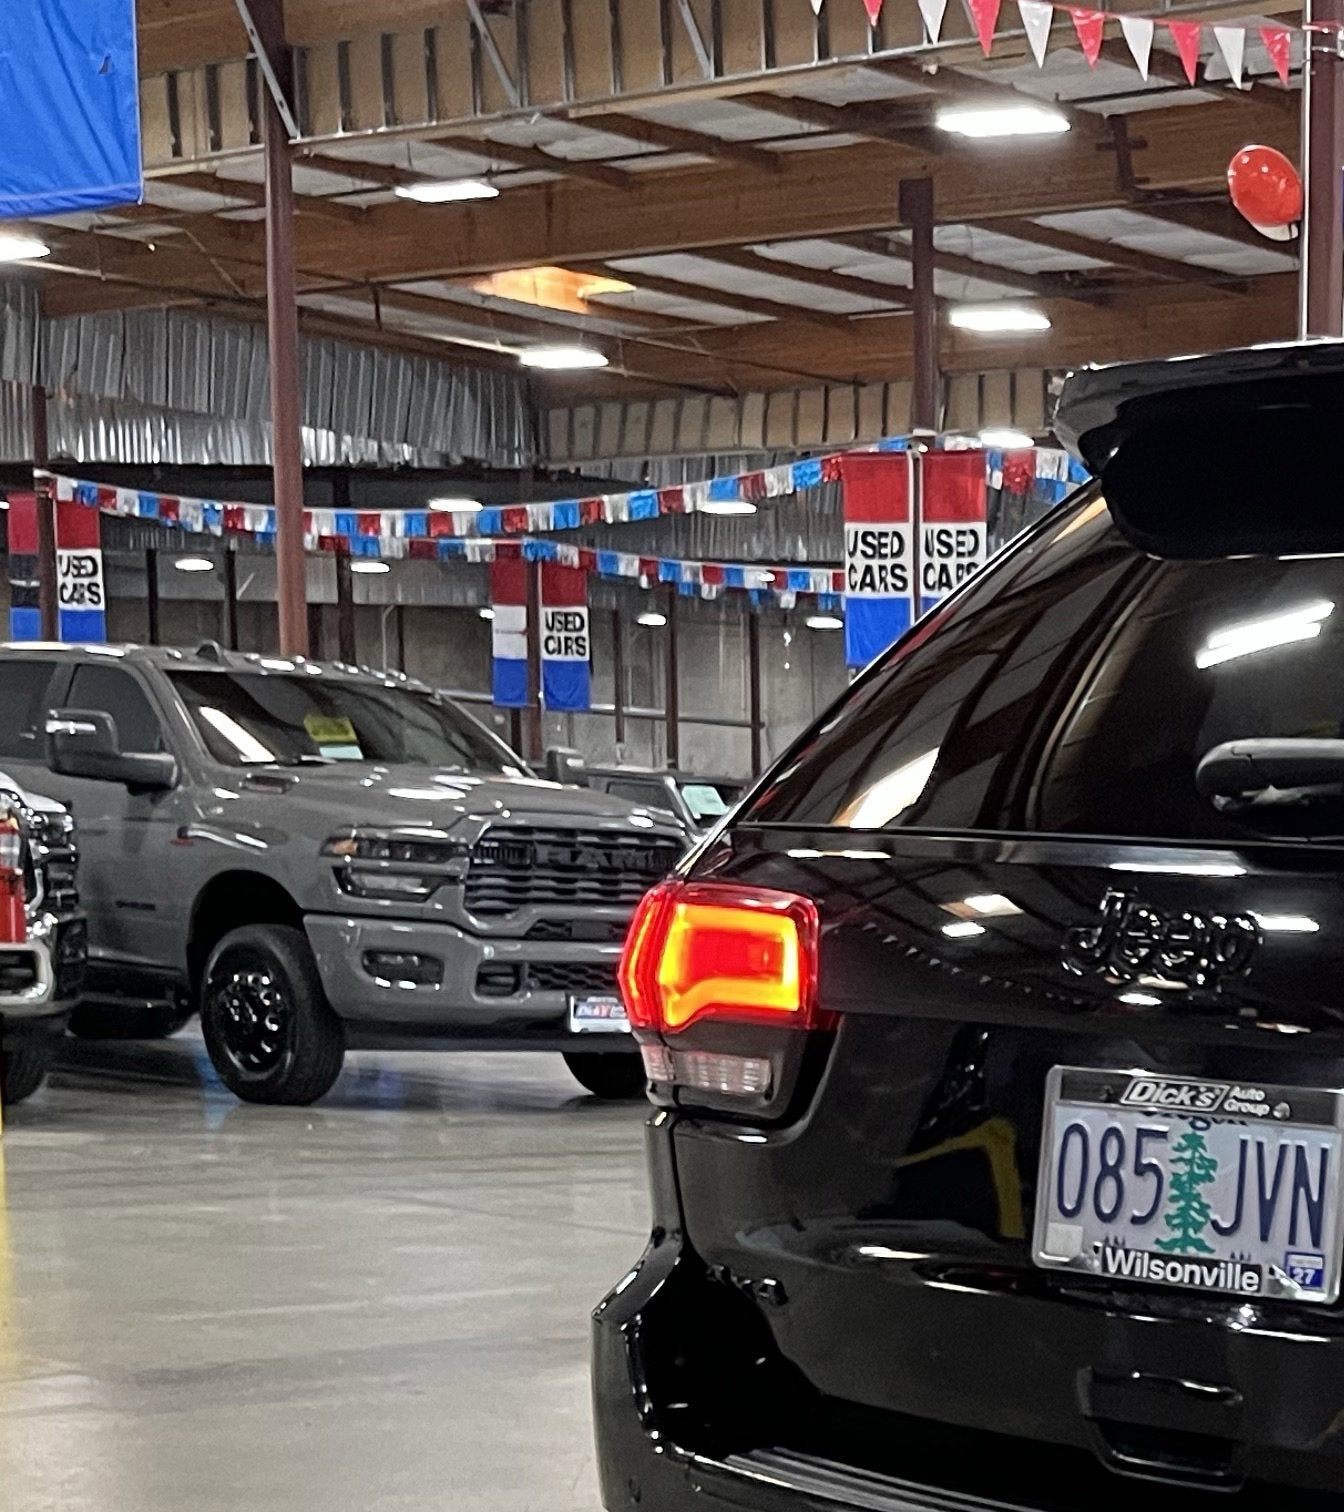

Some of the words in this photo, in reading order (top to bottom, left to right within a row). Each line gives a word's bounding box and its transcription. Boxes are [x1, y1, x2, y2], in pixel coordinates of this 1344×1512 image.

[847, 530, 905, 560] USED
[924, 528, 979, 558] USED
[848, 563, 908, 592] CARS
[545, 611, 585, 632] USED
[1058, 886, 1265, 995] Jeep
[1129, 1081, 1216, 1107] Dick's
[1224, 1099, 1270, 1117] Group
[1229, 1086, 1265, 1101] Auto
[1056, 1121, 1169, 1226] 085
[1211, 1133, 1332, 1249] JVN
[1104, 1248, 1260, 1292] Wilsonville
